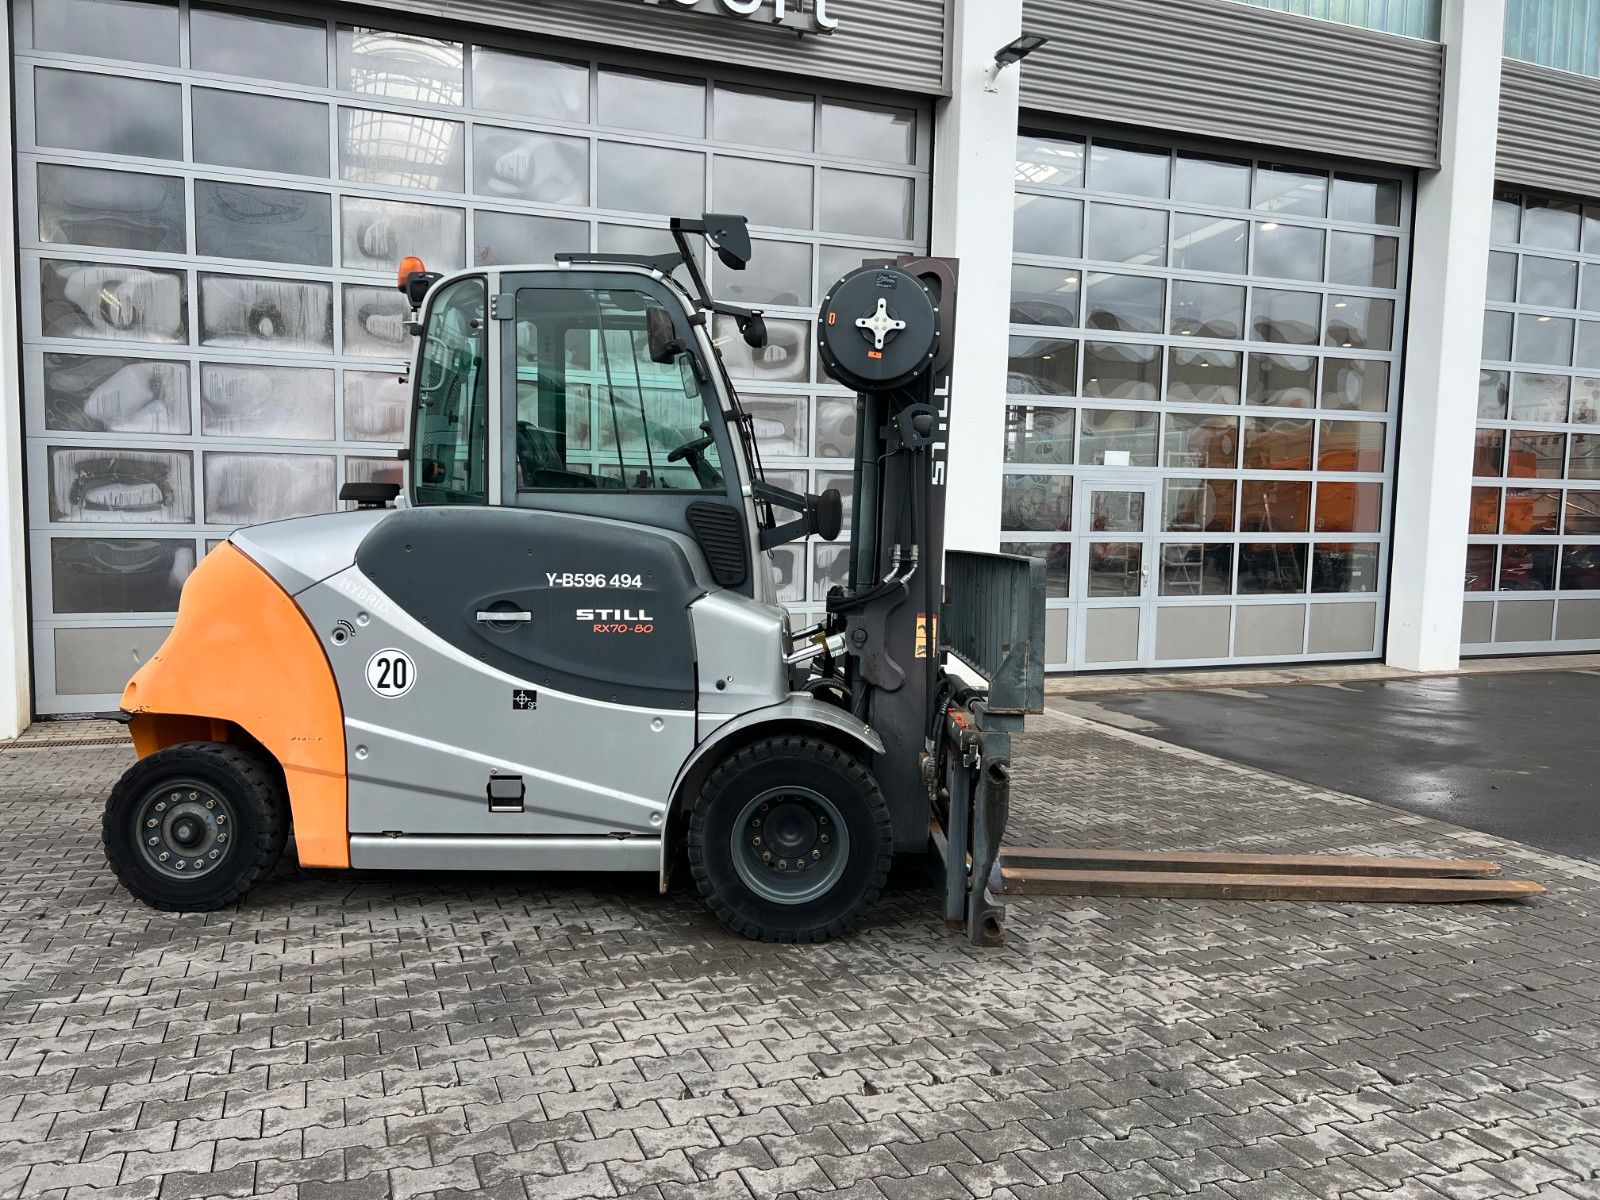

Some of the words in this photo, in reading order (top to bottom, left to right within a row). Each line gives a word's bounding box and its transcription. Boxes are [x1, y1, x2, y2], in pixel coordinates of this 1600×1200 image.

[545, 572, 607, 588] Y-B596
[609, 573, 643, 588] 494
[338, 577, 390, 613] HYBRID
[576, 609, 654, 621] STILL
[593, 624, 654, 633] RX70-80
[376, 657, 407, 689] 20
